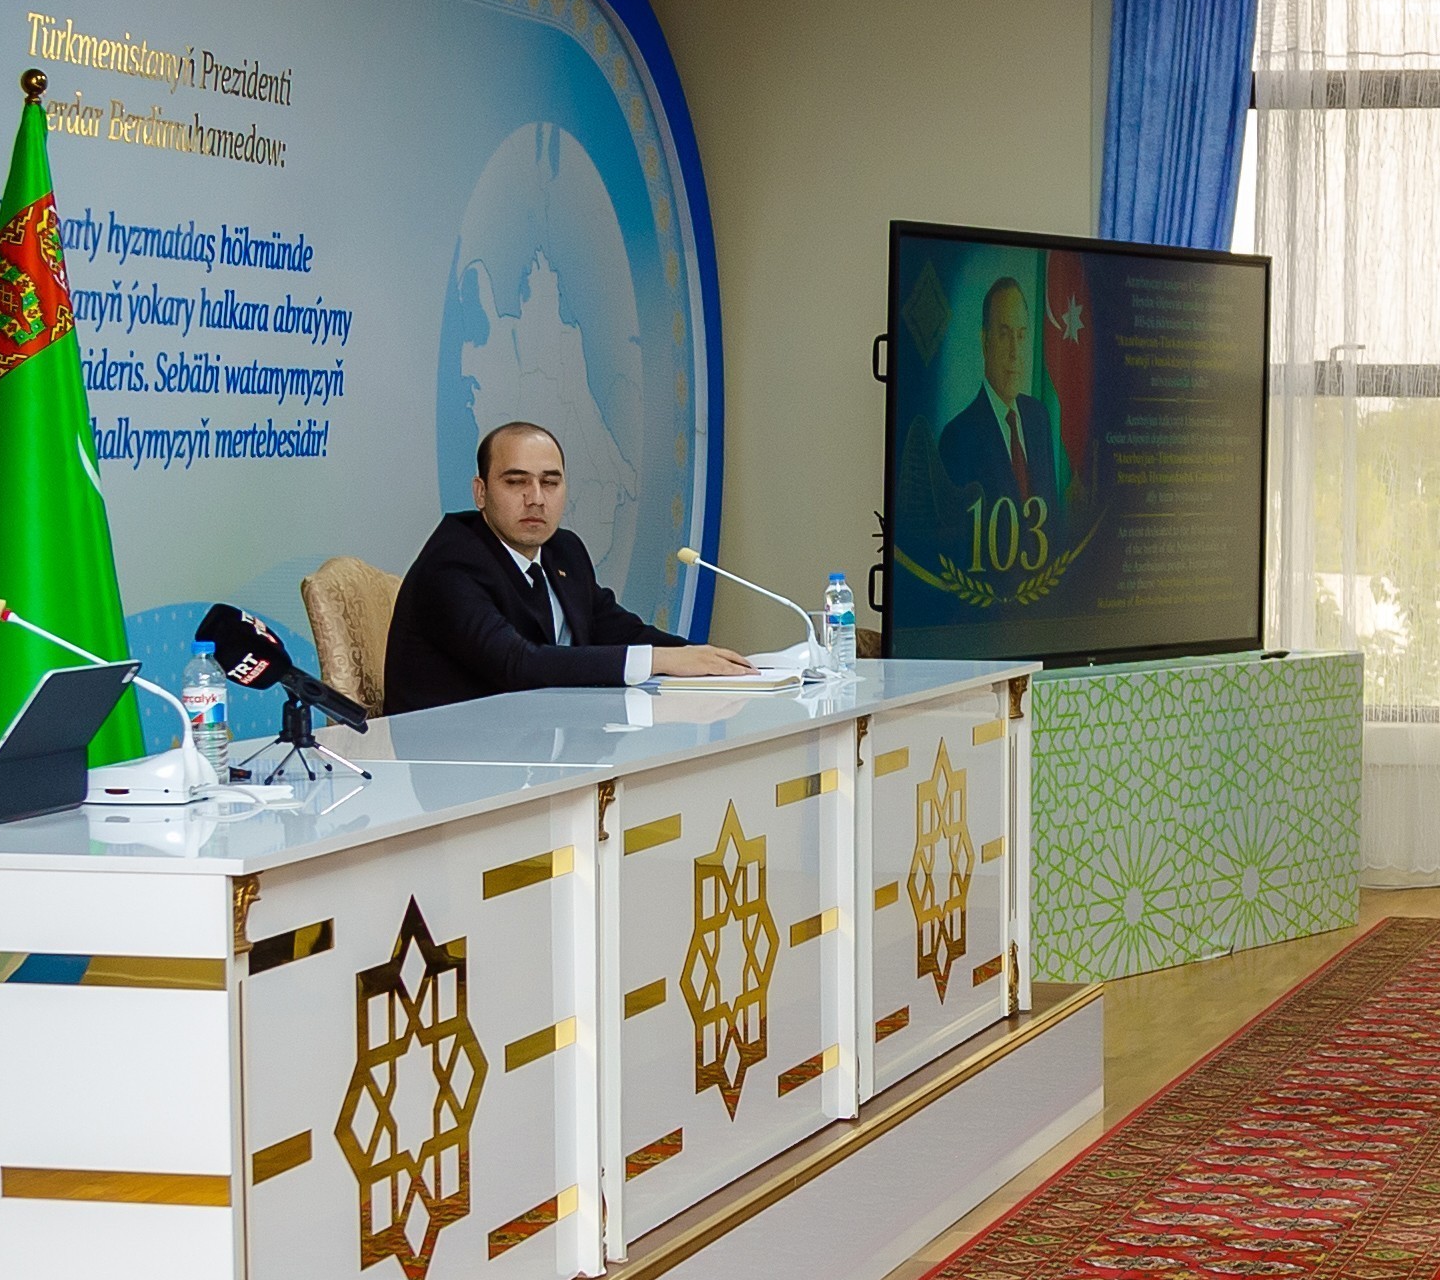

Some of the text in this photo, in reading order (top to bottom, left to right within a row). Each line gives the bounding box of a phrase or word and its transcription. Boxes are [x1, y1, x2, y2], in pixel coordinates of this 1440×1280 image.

[28, 12, 292, 107] Türkmenistanyň Prezidenti
[44, 90, 287, 169] erdar Berdimuhamedow:
[107, 210, 216, 274] hyzmatdaş
[219, 223, 314, 273] hökmünde
[127, 278, 196, 338] ýokary
[199, 286, 269, 332] halkara
[273, 293, 353, 347] abraýyny
[81, 347, 345, 407] ideris. Sebäbi watanymyzyň
[214, 417, 330, 459] mertebesidir!
[967, 496, 1049, 573] 103
[227, 652, 259, 680] TRT
